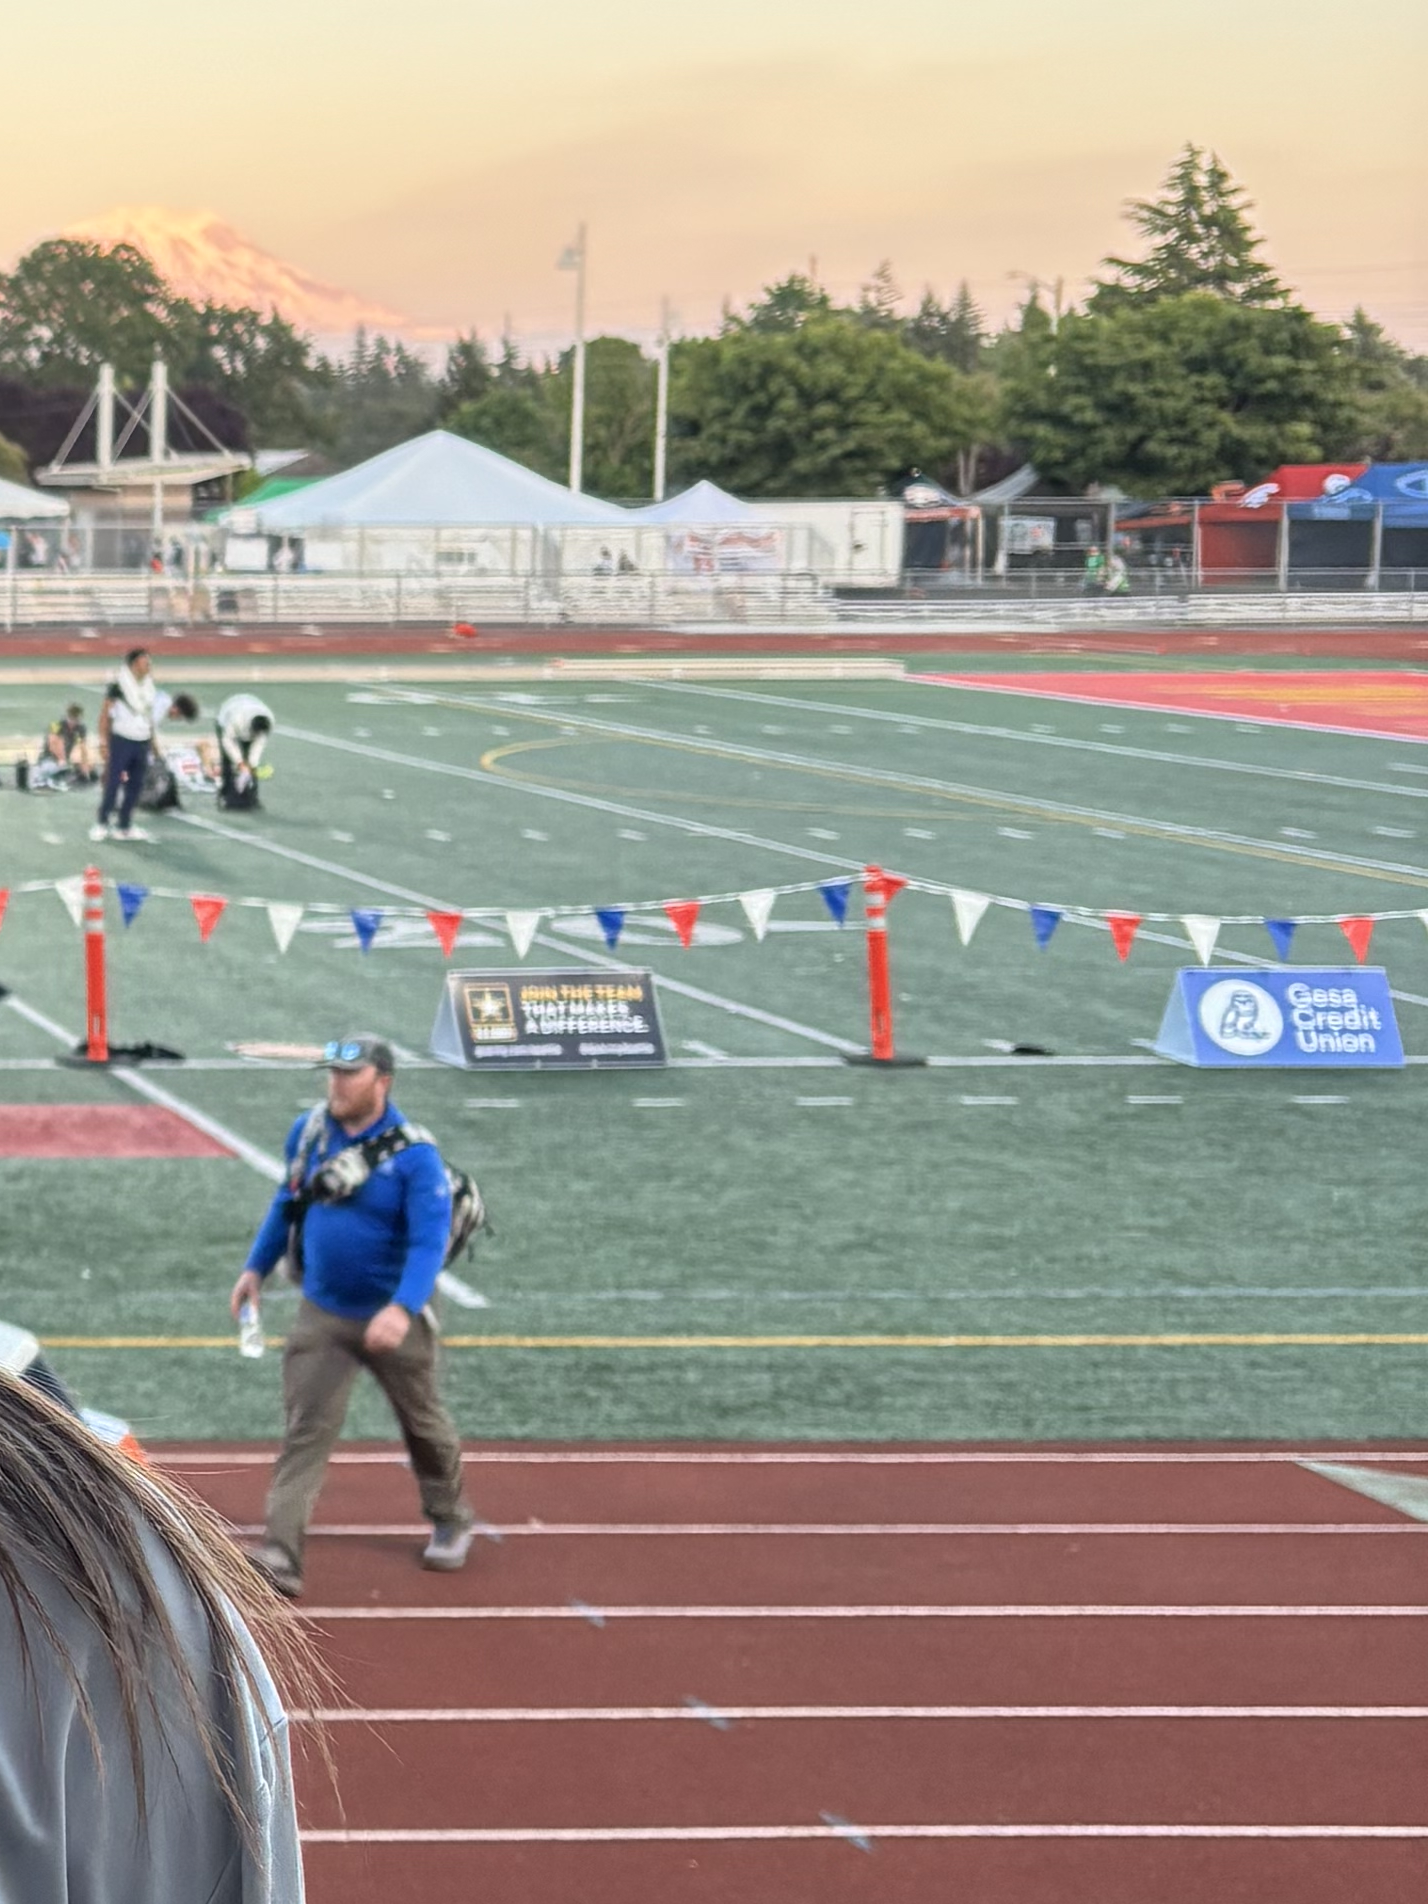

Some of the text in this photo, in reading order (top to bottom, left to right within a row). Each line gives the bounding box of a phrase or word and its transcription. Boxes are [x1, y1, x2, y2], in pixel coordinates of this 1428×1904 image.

[561, 985, 593, 1001] THE
[596, 984, 644, 1001] TEAM
[1287, 982, 1358, 1009] Gesa
[522, 1000, 630, 1016] THAT MAKES
[1291, 1004, 1382, 1031] Credit
[526, 1016, 541, 1034] A
[1297, 1030, 1376, 1053] Union
